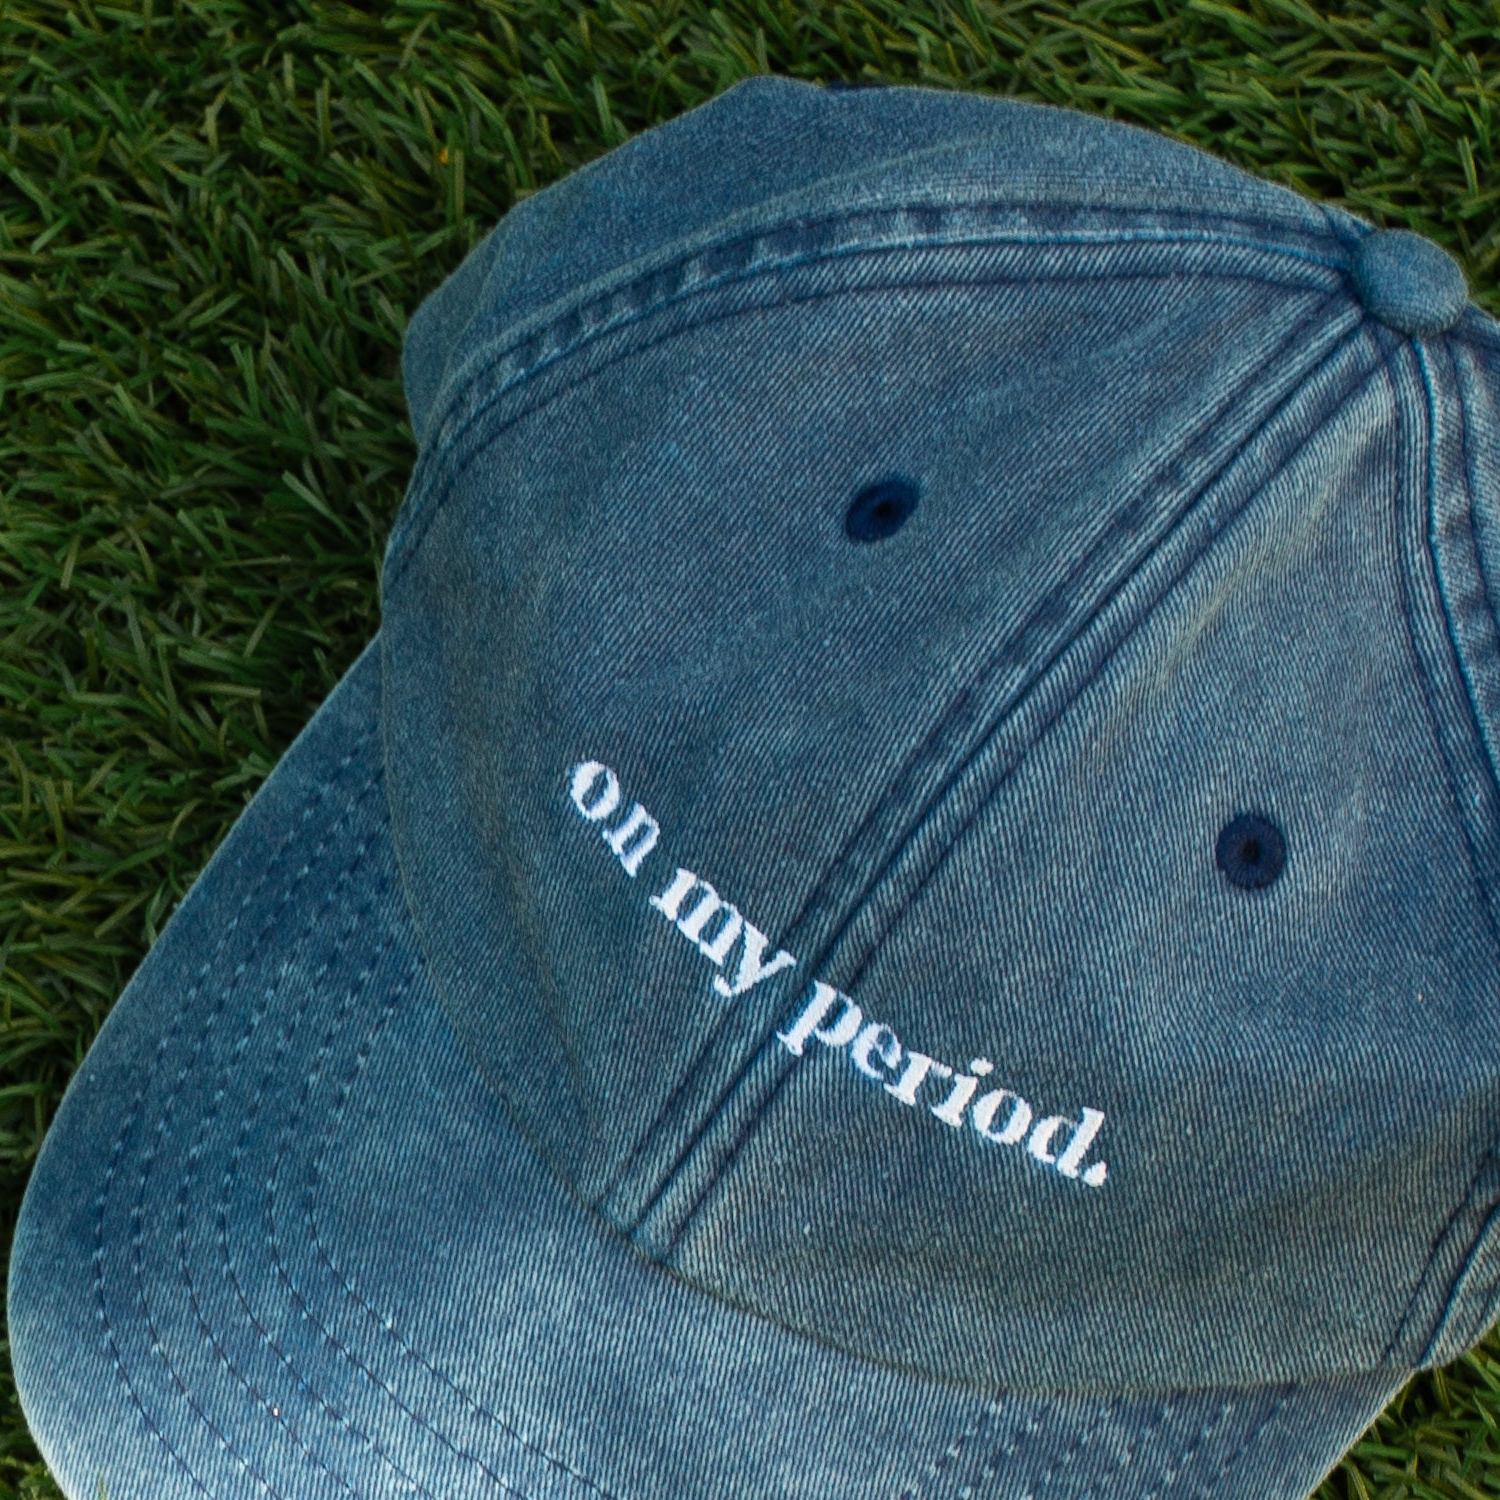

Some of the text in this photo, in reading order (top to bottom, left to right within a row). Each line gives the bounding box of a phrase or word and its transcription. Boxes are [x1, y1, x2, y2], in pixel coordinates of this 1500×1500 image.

[569, 760, 1108, 1187] on my period.
